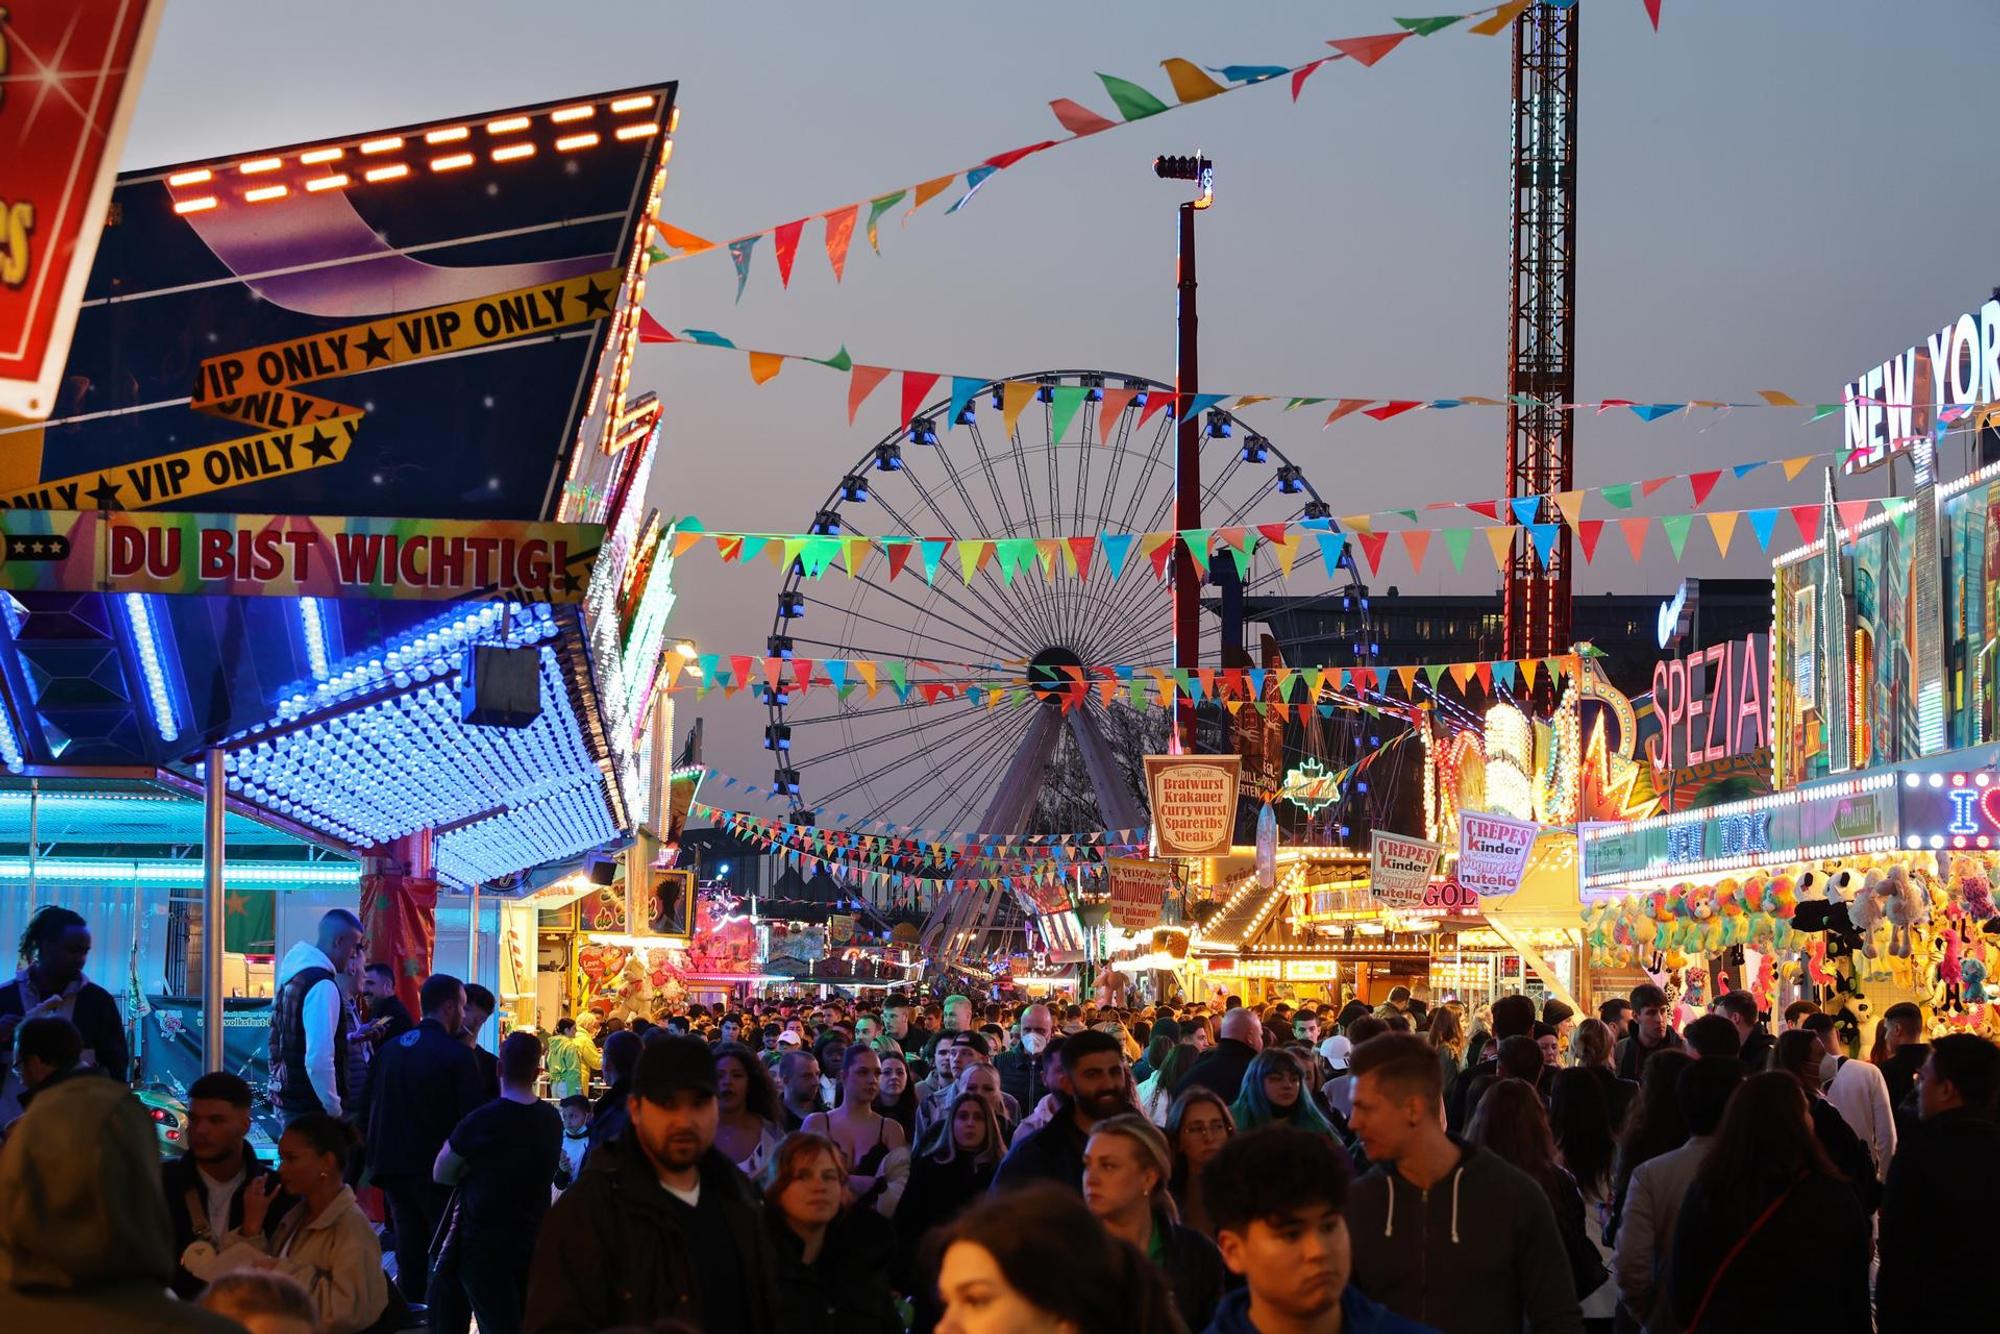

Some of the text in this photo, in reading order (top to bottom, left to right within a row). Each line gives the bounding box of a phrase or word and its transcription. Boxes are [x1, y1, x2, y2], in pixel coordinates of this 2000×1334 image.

[258, 333, 349, 386] ONLY
[397, 310, 460, 354] VIP
[474, 286, 566, 337] ONLY
[1844, 346, 1917, 475] NEW
[128, 458, 190, 502] VIP
[203, 433, 294, 485] ONLY
[109, 526, 568, 592] DU BIST WICHTIG!
[1163, 778, 1224, 790] Bratwurst
[1164, 791, 1223, 803] Krakauer
[1161, 804, 1227, 817] Currywurst
[1165, 817, 1222, 831] Spareribs
[1174, 831, 1213, 842] Steaks
[1719, 811, 1769, 857] YORK
[1468, 836, 1521, 855] kinder
[1380, 854, 1428, 873] kinder
[1121, 868, 1156, 880] Frische
[1461, 874, 1516, 887] nutella
[1372, 888, 1421, 900] nutella
[1112, 905, 1157, 918] mit pikanten
[1122, 915, 1146, 926] Saucen
